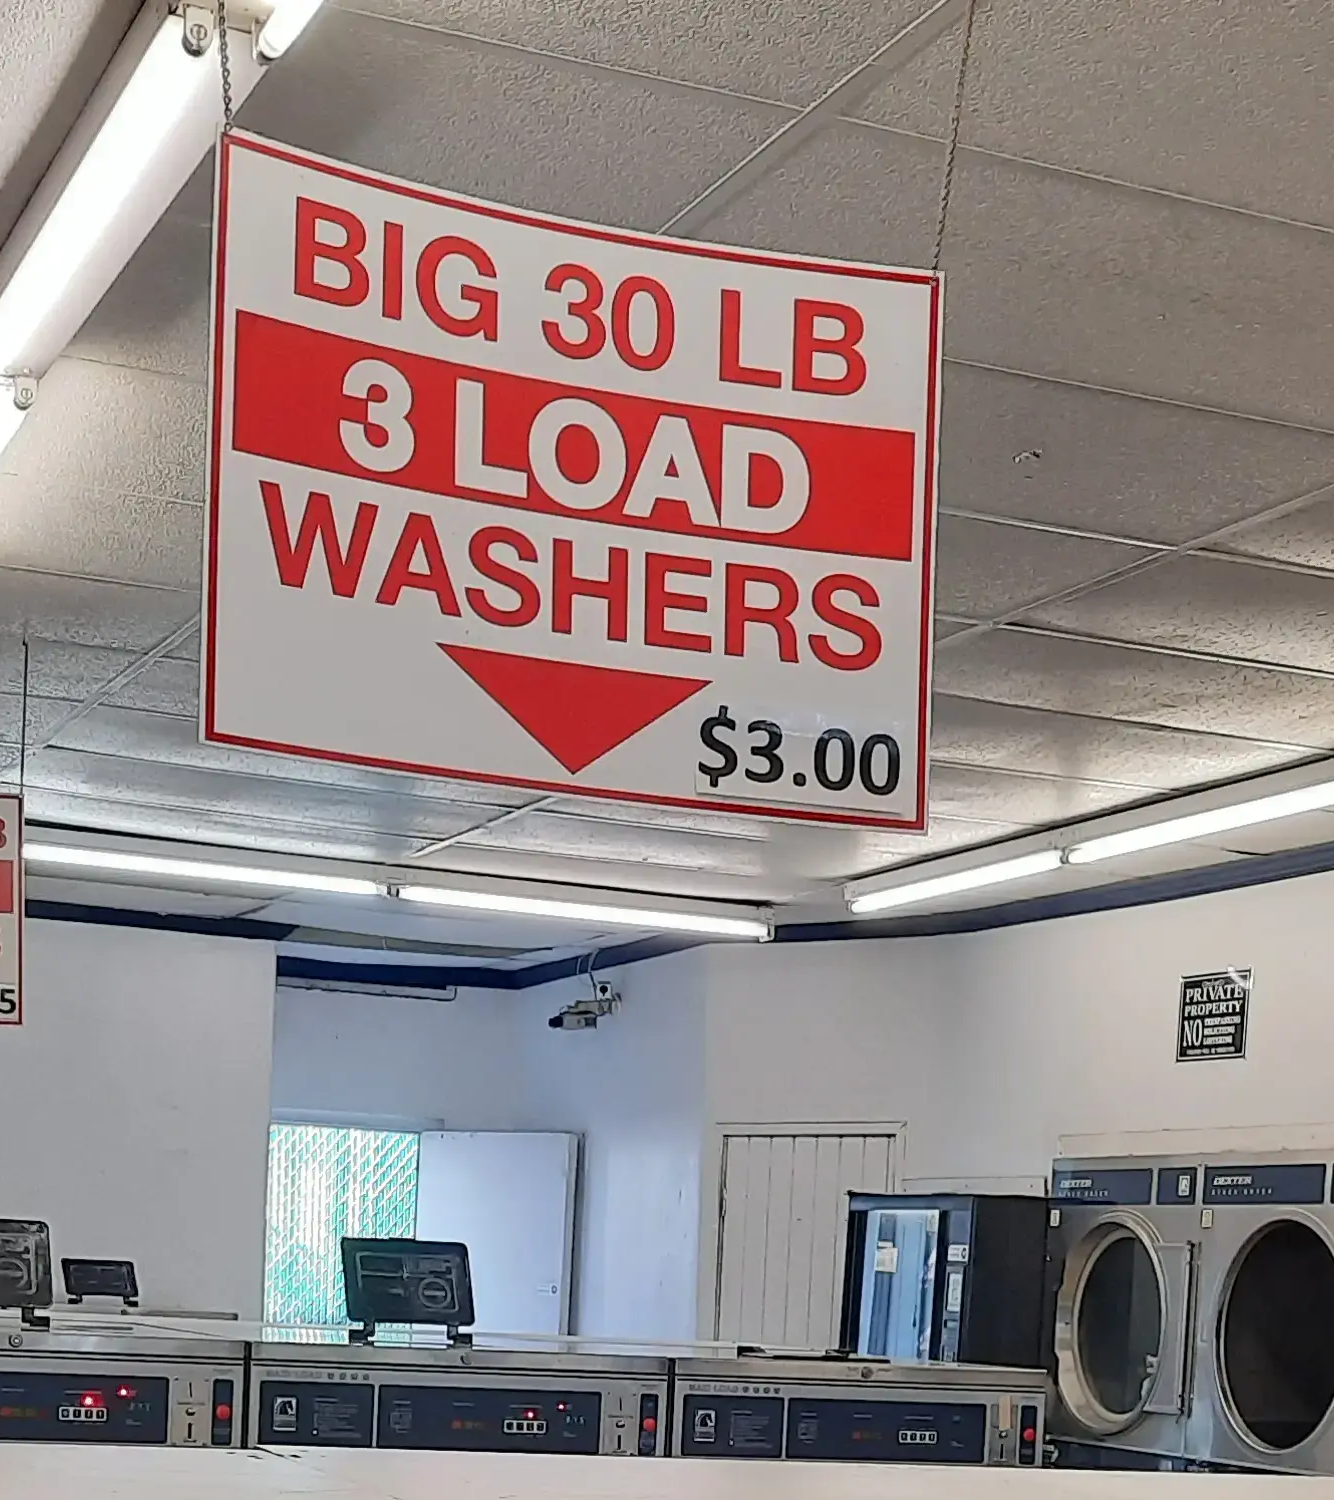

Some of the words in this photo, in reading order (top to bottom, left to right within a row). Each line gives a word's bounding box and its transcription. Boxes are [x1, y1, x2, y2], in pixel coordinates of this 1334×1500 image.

[294, 196, 500, 342] BIG
[541, 263, 675, 371] 30
[719, 288, 867, 396] LB
[339, 359, 414, 472] 3
[454, 379, 810, 534] LOAD
[259, 479, 882, 671] WASHERS
[697, 706, 901, 795] $3.00
[1184, 1000, 1243, 1017] PROPERTY
[1186, 983, 1244, 1003] PRIVATE
[1183, 1018, 1203, 1047] NO
[1213, 1175, 1252, 1186] DEXTER
